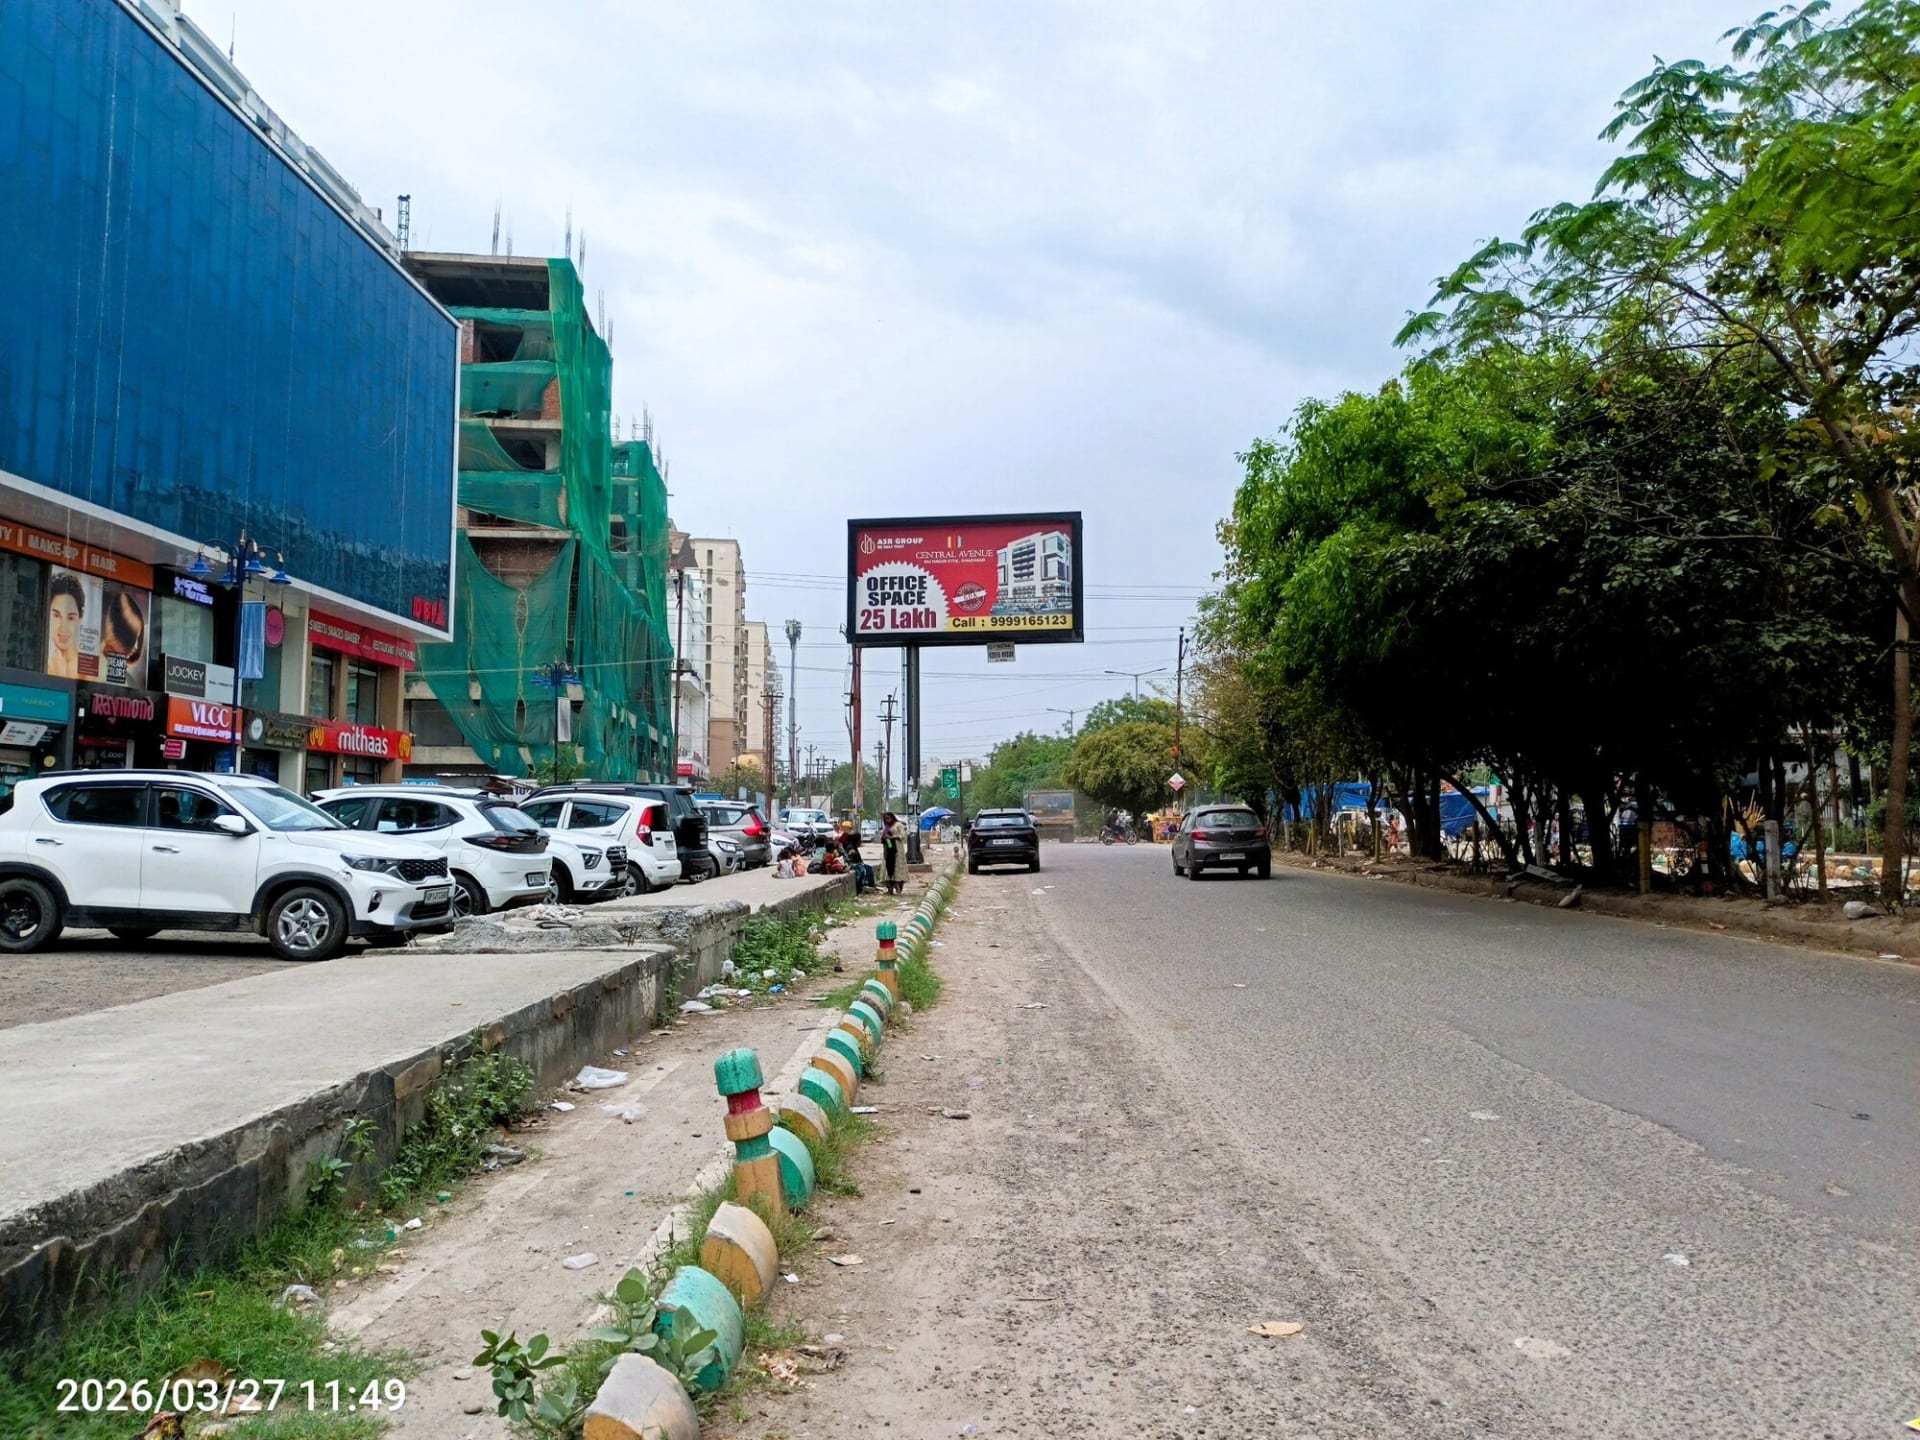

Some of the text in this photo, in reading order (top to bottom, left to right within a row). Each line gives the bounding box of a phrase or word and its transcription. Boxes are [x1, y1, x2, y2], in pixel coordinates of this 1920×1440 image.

[916, 550, 994, 559] CENTRAL AVENUE
[90, 554, 116, 572] HAIR
[866, 576, 927, 591] OFFICE
[868, 591, 926, 606] SPACE
[860, 608, 937, 630] 25 Lakh
[952, 618, 975, 627] Call
[991, 615, 1067, 626] 9999165123
[168, 665, 204, 680] JOCKEY
[92, 693, 154, 724] Raymond
[191, 702, 229, 727] VLCC
[338, 726, 388, 754] mithaas
